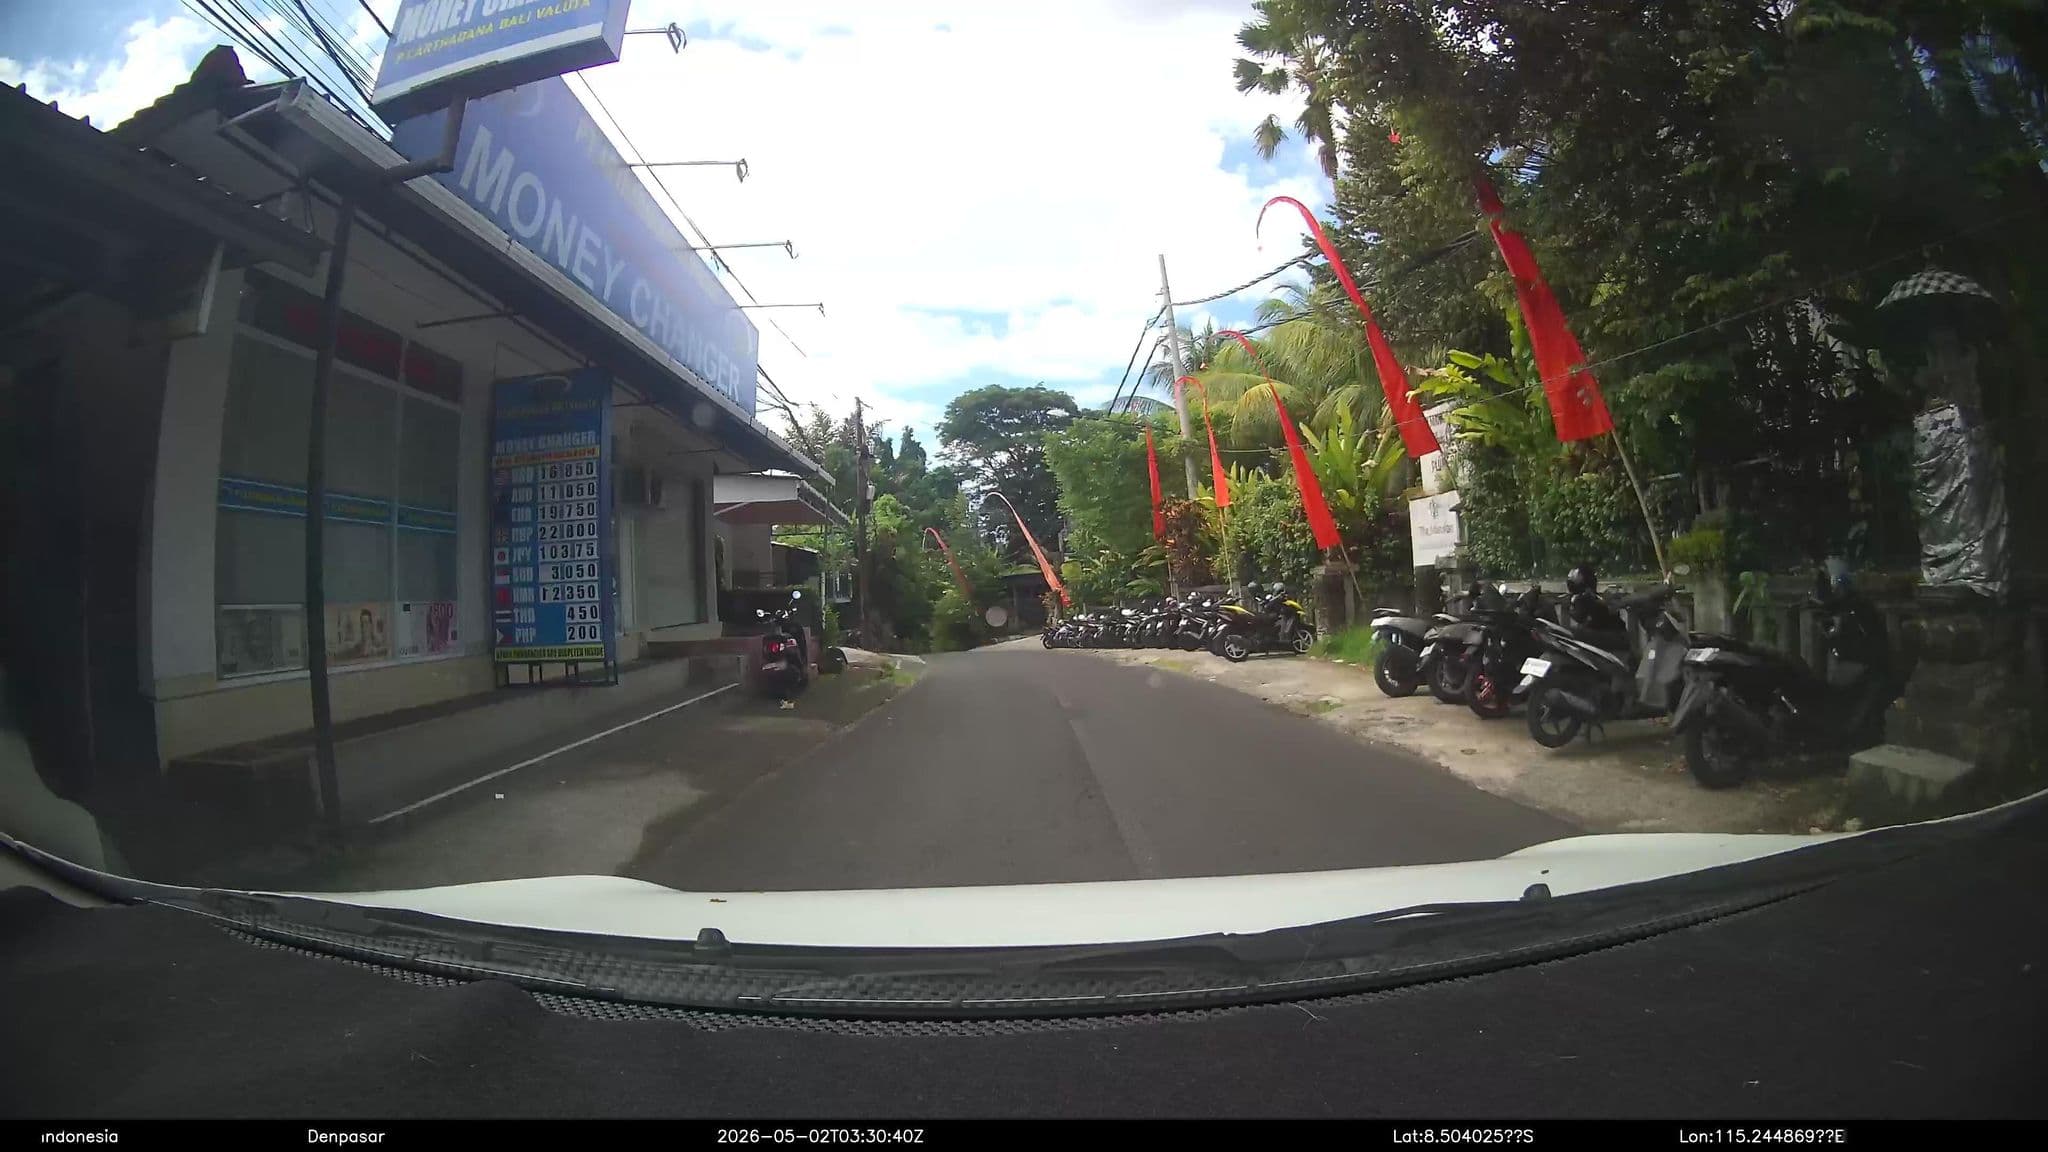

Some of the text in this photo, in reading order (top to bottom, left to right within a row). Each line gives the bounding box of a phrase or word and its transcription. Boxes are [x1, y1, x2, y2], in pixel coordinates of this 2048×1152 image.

[459, 124, 626, 302] MONEY
[630, 278, 740, 402] CHANGER
[567, 604, 598, 621] 450
[568, 625, 598, 641] 200
